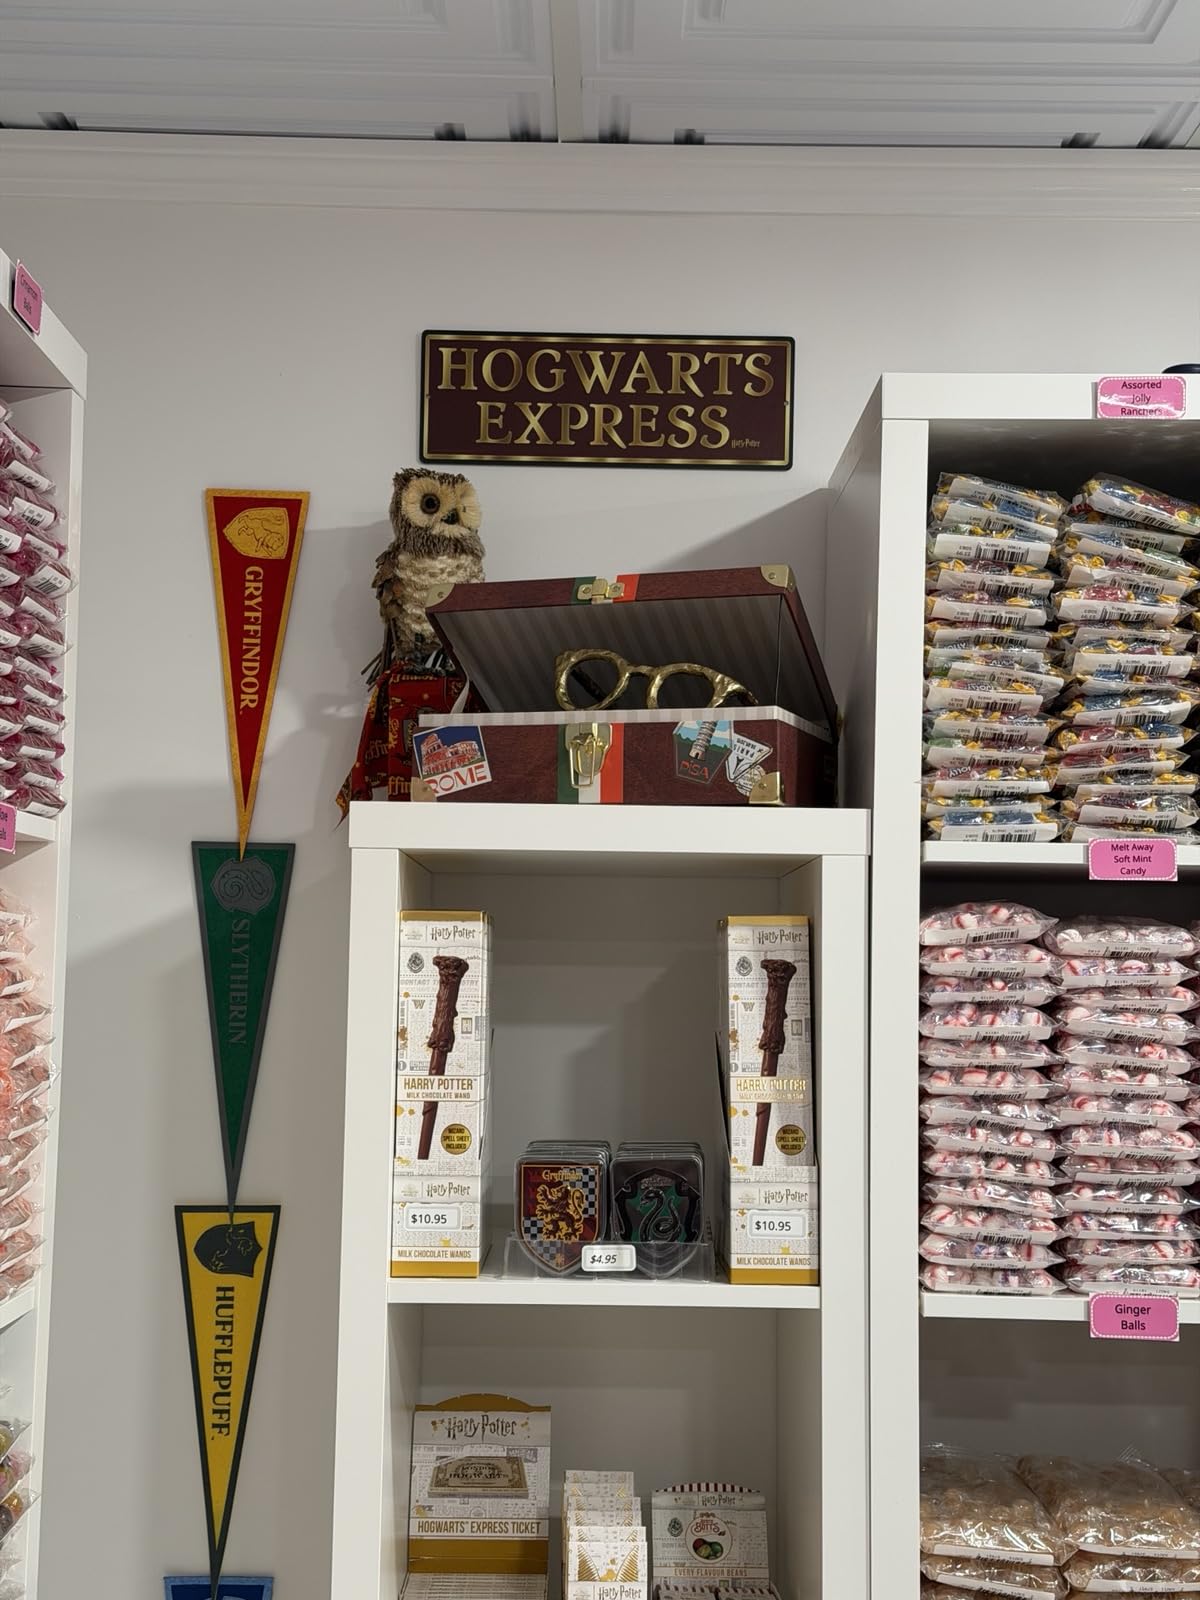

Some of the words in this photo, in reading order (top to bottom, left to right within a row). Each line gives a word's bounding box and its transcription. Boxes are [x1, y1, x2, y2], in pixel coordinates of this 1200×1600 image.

[437, 347, 774, 398] HOGWARTS
[1121, 380, 1162, 389] Assorted
[476, 401, 730, 450] EXPRESS
[731, 439, 745, 449] Harry
[745, 439, 761, 448] Potter
[238, 566, 264, 709] GRYFFINDOR
[733, 744, 755, 758] PARIS
[423, 764, 487, 794] ROME
[1111, 843, 1130, 851] Melt
[1131, 843, 1154, 853] Away
[1113, 855, 1130, 863] Soft
[1132, 855, 1152, 863] Mint
[1120, 867, 1147, 876] Candy
[431, 926, 453, 941] Harry
[452, 925, 476, 941] Potter
[758, 930, 779, 944] Harry
[779, 929, 802, 944] Potter
[228, 919, 251, 1045] SLYTHERIN
[404, 1078, 435, 1089] HARRY
[438, 1078, 473, 1090] POTTER
[736, 1079, 768, 1091] HARRY
[769, 1079, 806, 1091] POTTER
[426, 1183, 447, 1197] Harry
[447, 1181, 470, 1197] Potter
[764, 1189, 786, 1204] Harry
[785, 1188, 808, 1204] Potter
[411, 1213, 447, 1224] $10.95
[755, 1221, 791, 1232] $10.95
[398, 1250, 412, 1258] MILK
[413, 1250, 448, 1258] CHOCOLATE
[450, 1250, 471, 1259] WANDS
[590, 1255, 617, 1265] $4.95
[736, 1257, 752, 1265] MILK
[753, 1257, 788, 1266] CHOCOLATE
[789, 1257, 811, 1266] WANDS
[1114, 1303, 1152, 1317] Ginger
[1121, 1320, 1146, 1331] Balls
[212, 1286, 236, 1437] HUFFLEPUFF
[445, 1416, 479, 1440] Harry
[479, 1414, 517, 1441] Potter
[702, 1495, 718, 1506] Harry
[718, 1494, 736, 1505] Potter
[418, 1521, 465, 1533] HOGWARTS
[470, 1521, 509, 1533] EXPRESS
[511, 1521, 541, 1534] TICKET
[727, 1569, 748, 1577] BEANS
